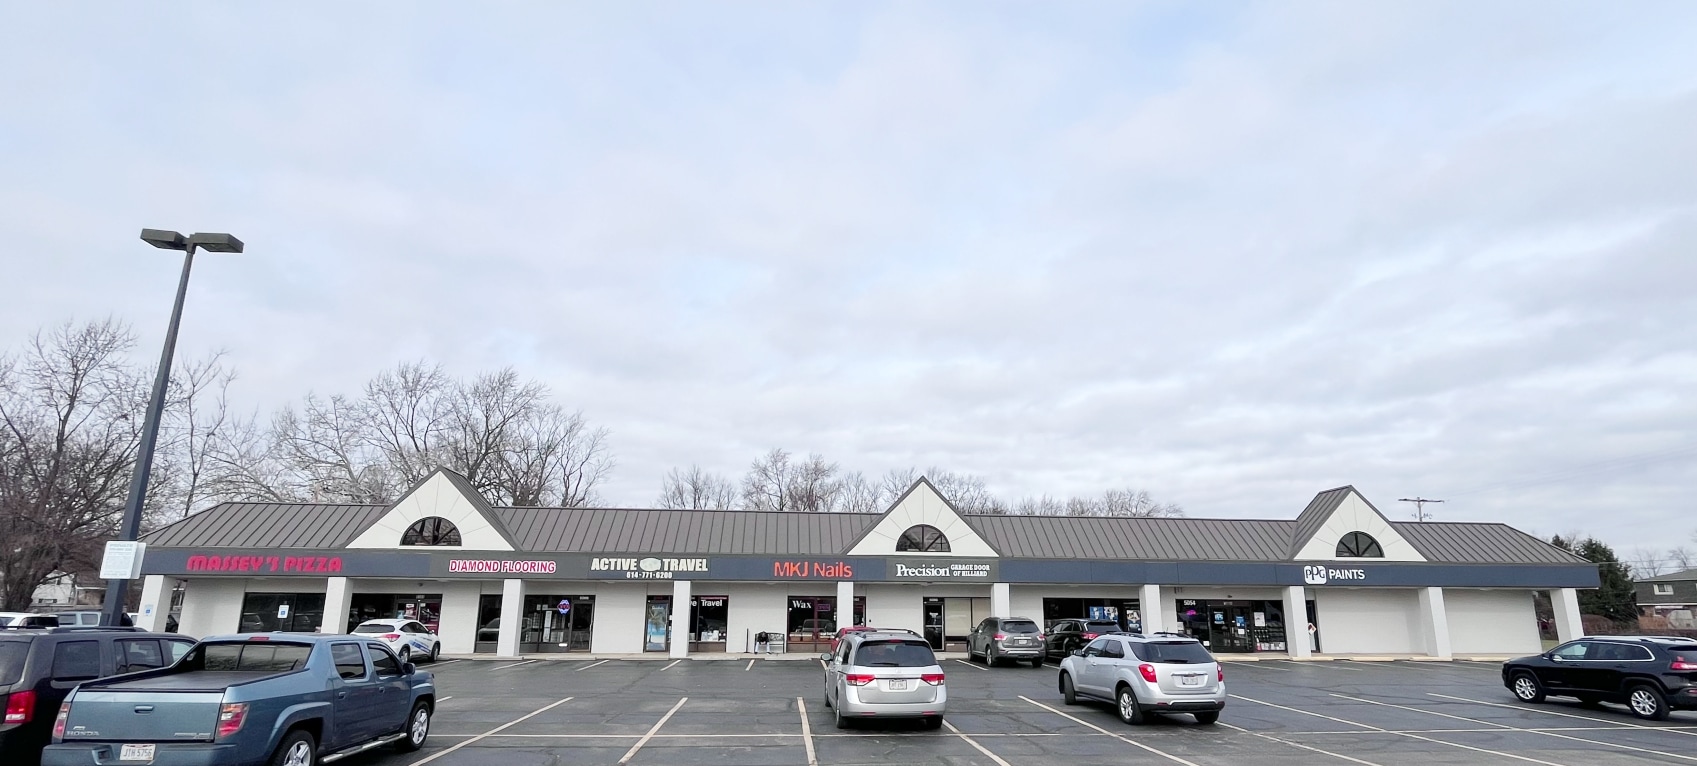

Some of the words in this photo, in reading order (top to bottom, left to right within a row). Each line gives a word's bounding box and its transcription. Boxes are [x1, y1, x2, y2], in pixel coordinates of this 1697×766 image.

[186, 555, 280, 573] MASSEY'S
[283, 556, 343, 573] PIZZA
[449, 560, 500, 572] DIAMOND
[501, 560, 556, 573] FLOORING
[591, 557, 638, 571] ACTIVE
[663, 558, 708, 571] TRAVEL
[774, 561, 809, 577] MKJ
[813, 561, 853, 578] Nails
[896, 563, 950, 577] Precision
[1304, 566, 1326, 582] PPG
[1328, 569, 1365, 580] PAINTS
[792, 600, 812, 609] Wax
